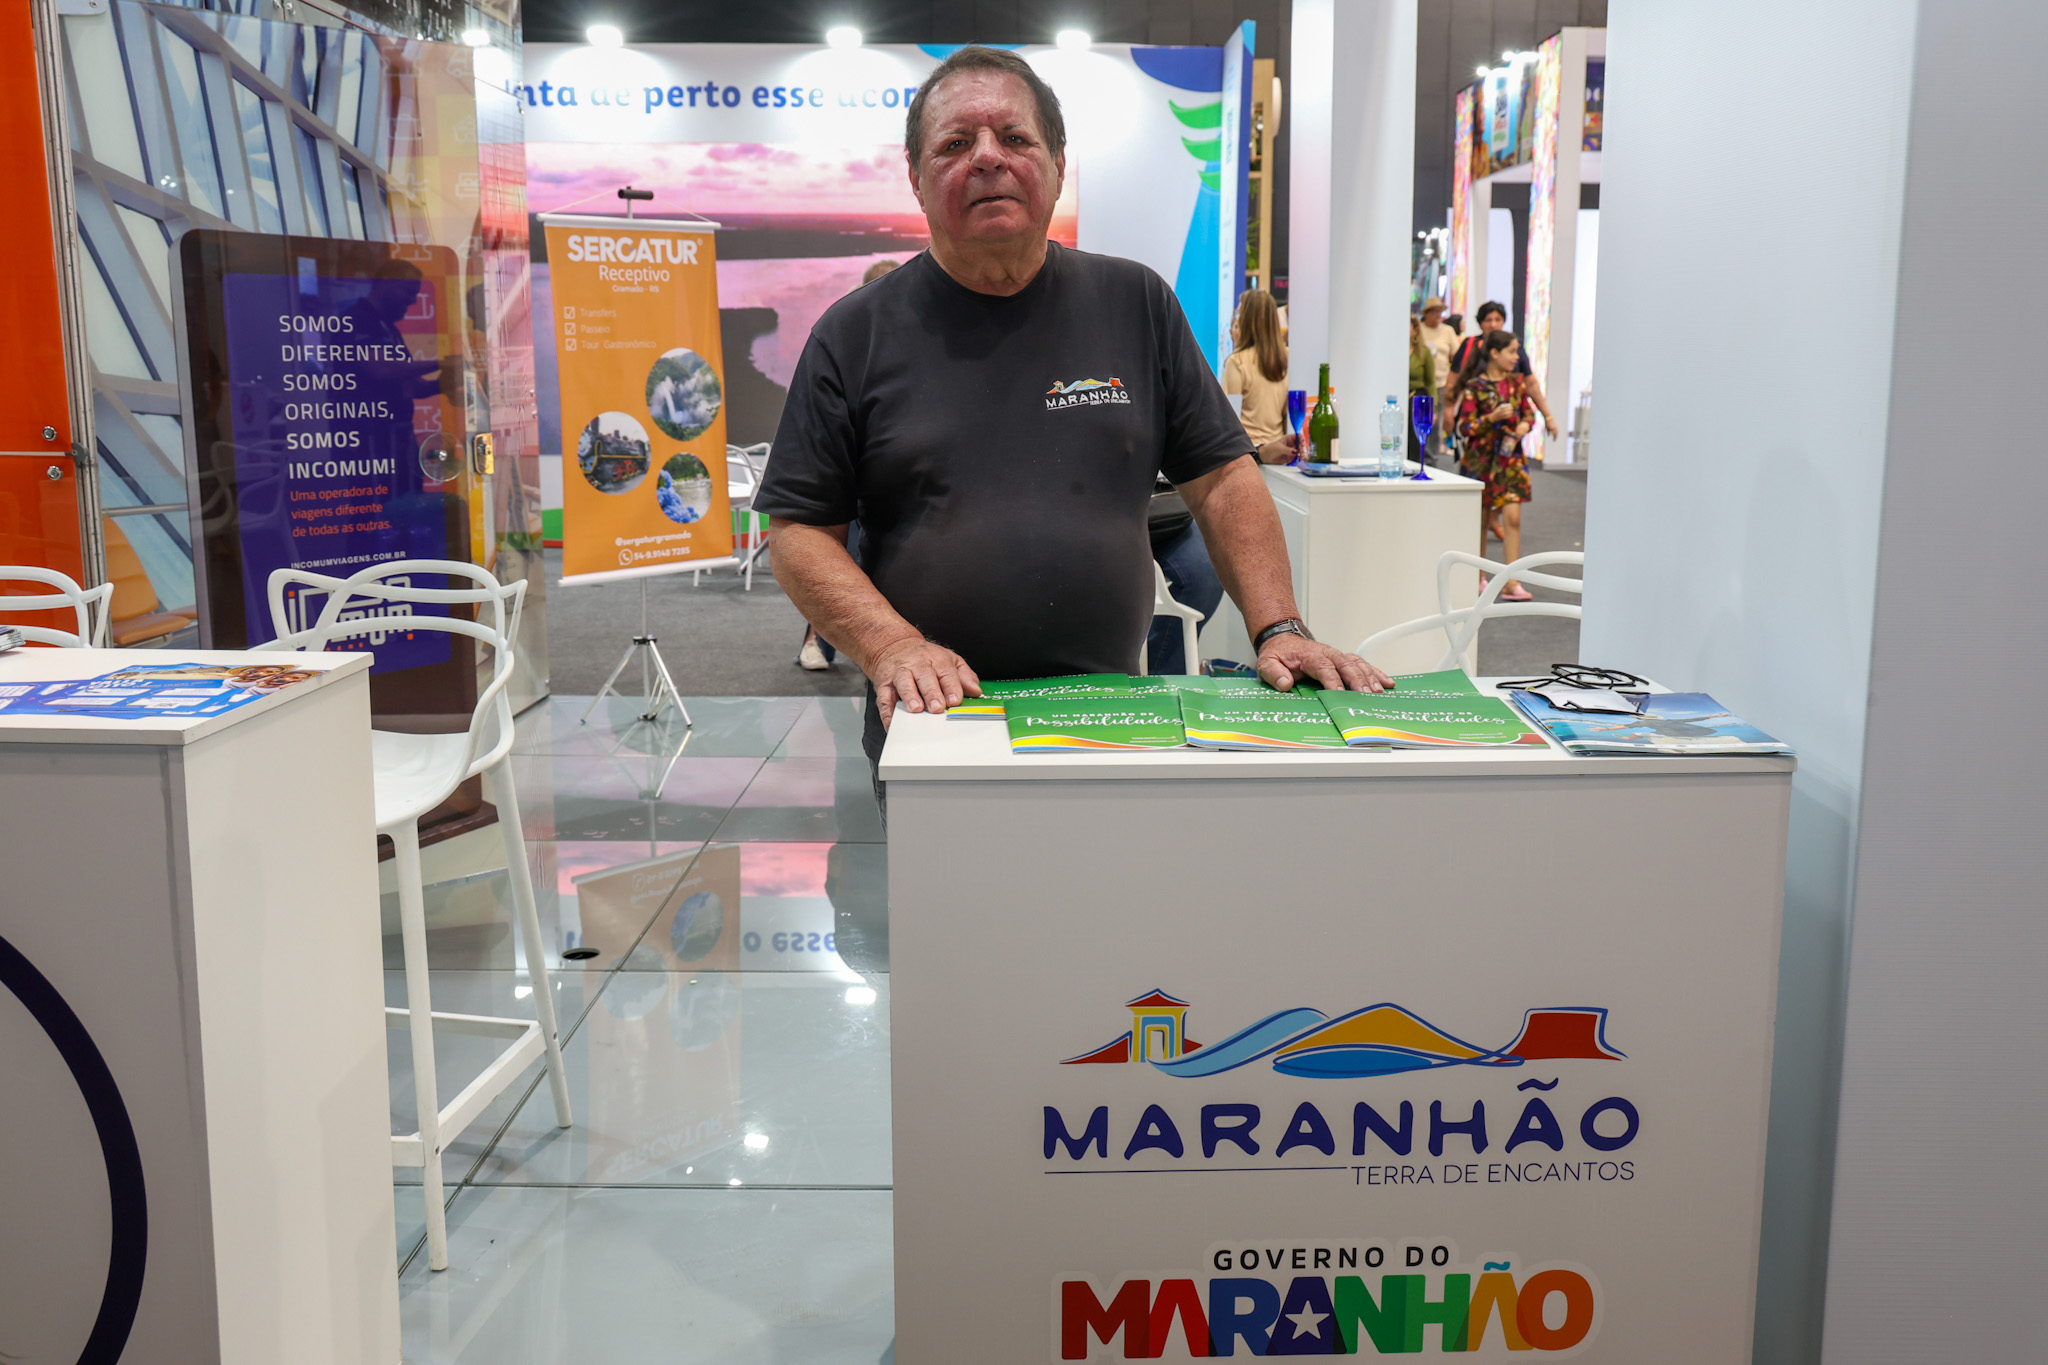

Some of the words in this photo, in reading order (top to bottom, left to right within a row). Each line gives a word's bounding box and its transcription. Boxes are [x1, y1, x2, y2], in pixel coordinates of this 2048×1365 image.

[644, 80, 742, 114] perto
[752, 85, 825, 108] esse
[598, 265, 671, 285] Receptivo
[278, 314, 354, 333] SOMOS
[281, 344, 412, 364] DIFERENTES,
[282, 373, 357, 392] SOMOS
[1045, 387, 1129, 409] MARANHÃO
[284, 401, 394, 421] ORIGINAIS,
[286, 430, 361, 450] SOMOS
[288, 458, 396, 480] INCOMUM!
[290, 490, 317, 502] Uma
[318, 486, 373, 501] operadora
[374, 484, 389, 495] de
[291, 507, 334, 522] viagens
[335, 503, 384, 516] diferente
[292, 526, 307, 538] de
[308, 524, 340, 537] todas
[341, 523, 354, 534] as
[290, 551, 407, 570] INCOMUMVIAGENS.COM.BR
[1026, 715, 1184, 727] Possibilidades
[1199, 712, 1335, 725] Possibilidad
[1347, 707, 1506, 725] Possibilidades
[1043, 1077, 1640, 1160] MARANHÃO
[1350, 1164, 1434, 1186] TERRA
[1443, 1163, 1479, 1184] DE
[1487, 1160, 1636, 1183] ENCANTOS
[1213, 1246, 1385, 1271] GOVERNO
[1405, 1244, 1451, 1267] DO
[1061, 1260, 1595, 1360] MARANHÃO
